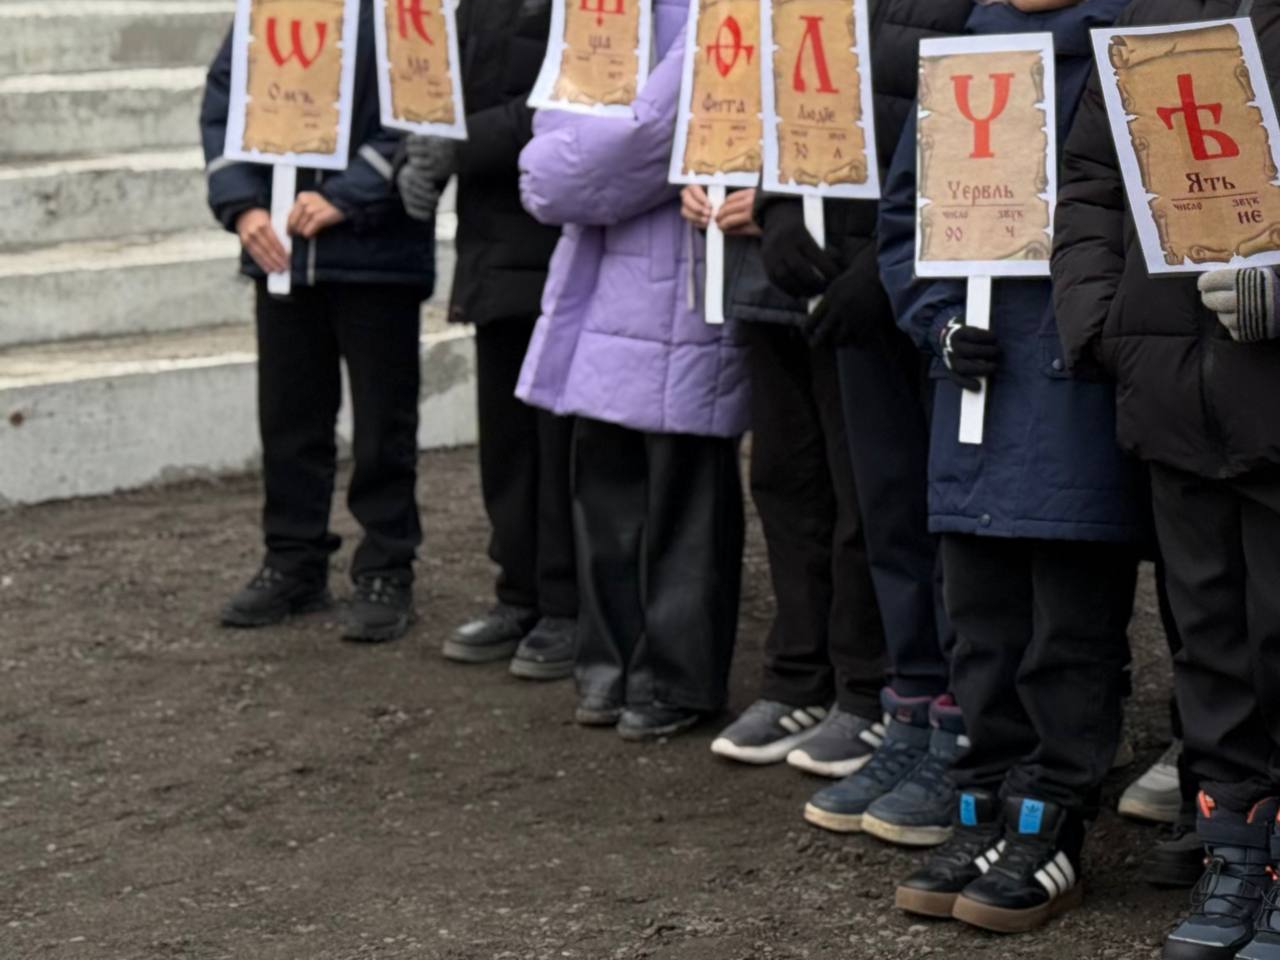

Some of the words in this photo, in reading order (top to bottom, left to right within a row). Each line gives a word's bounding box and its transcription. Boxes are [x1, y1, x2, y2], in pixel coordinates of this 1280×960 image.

[1185, 172, 1236, 194] Ять
[1173, 202, 1203, 211] число
[1232, 197, 1260, 209] звук
[945, 226, 963, 242] 90
